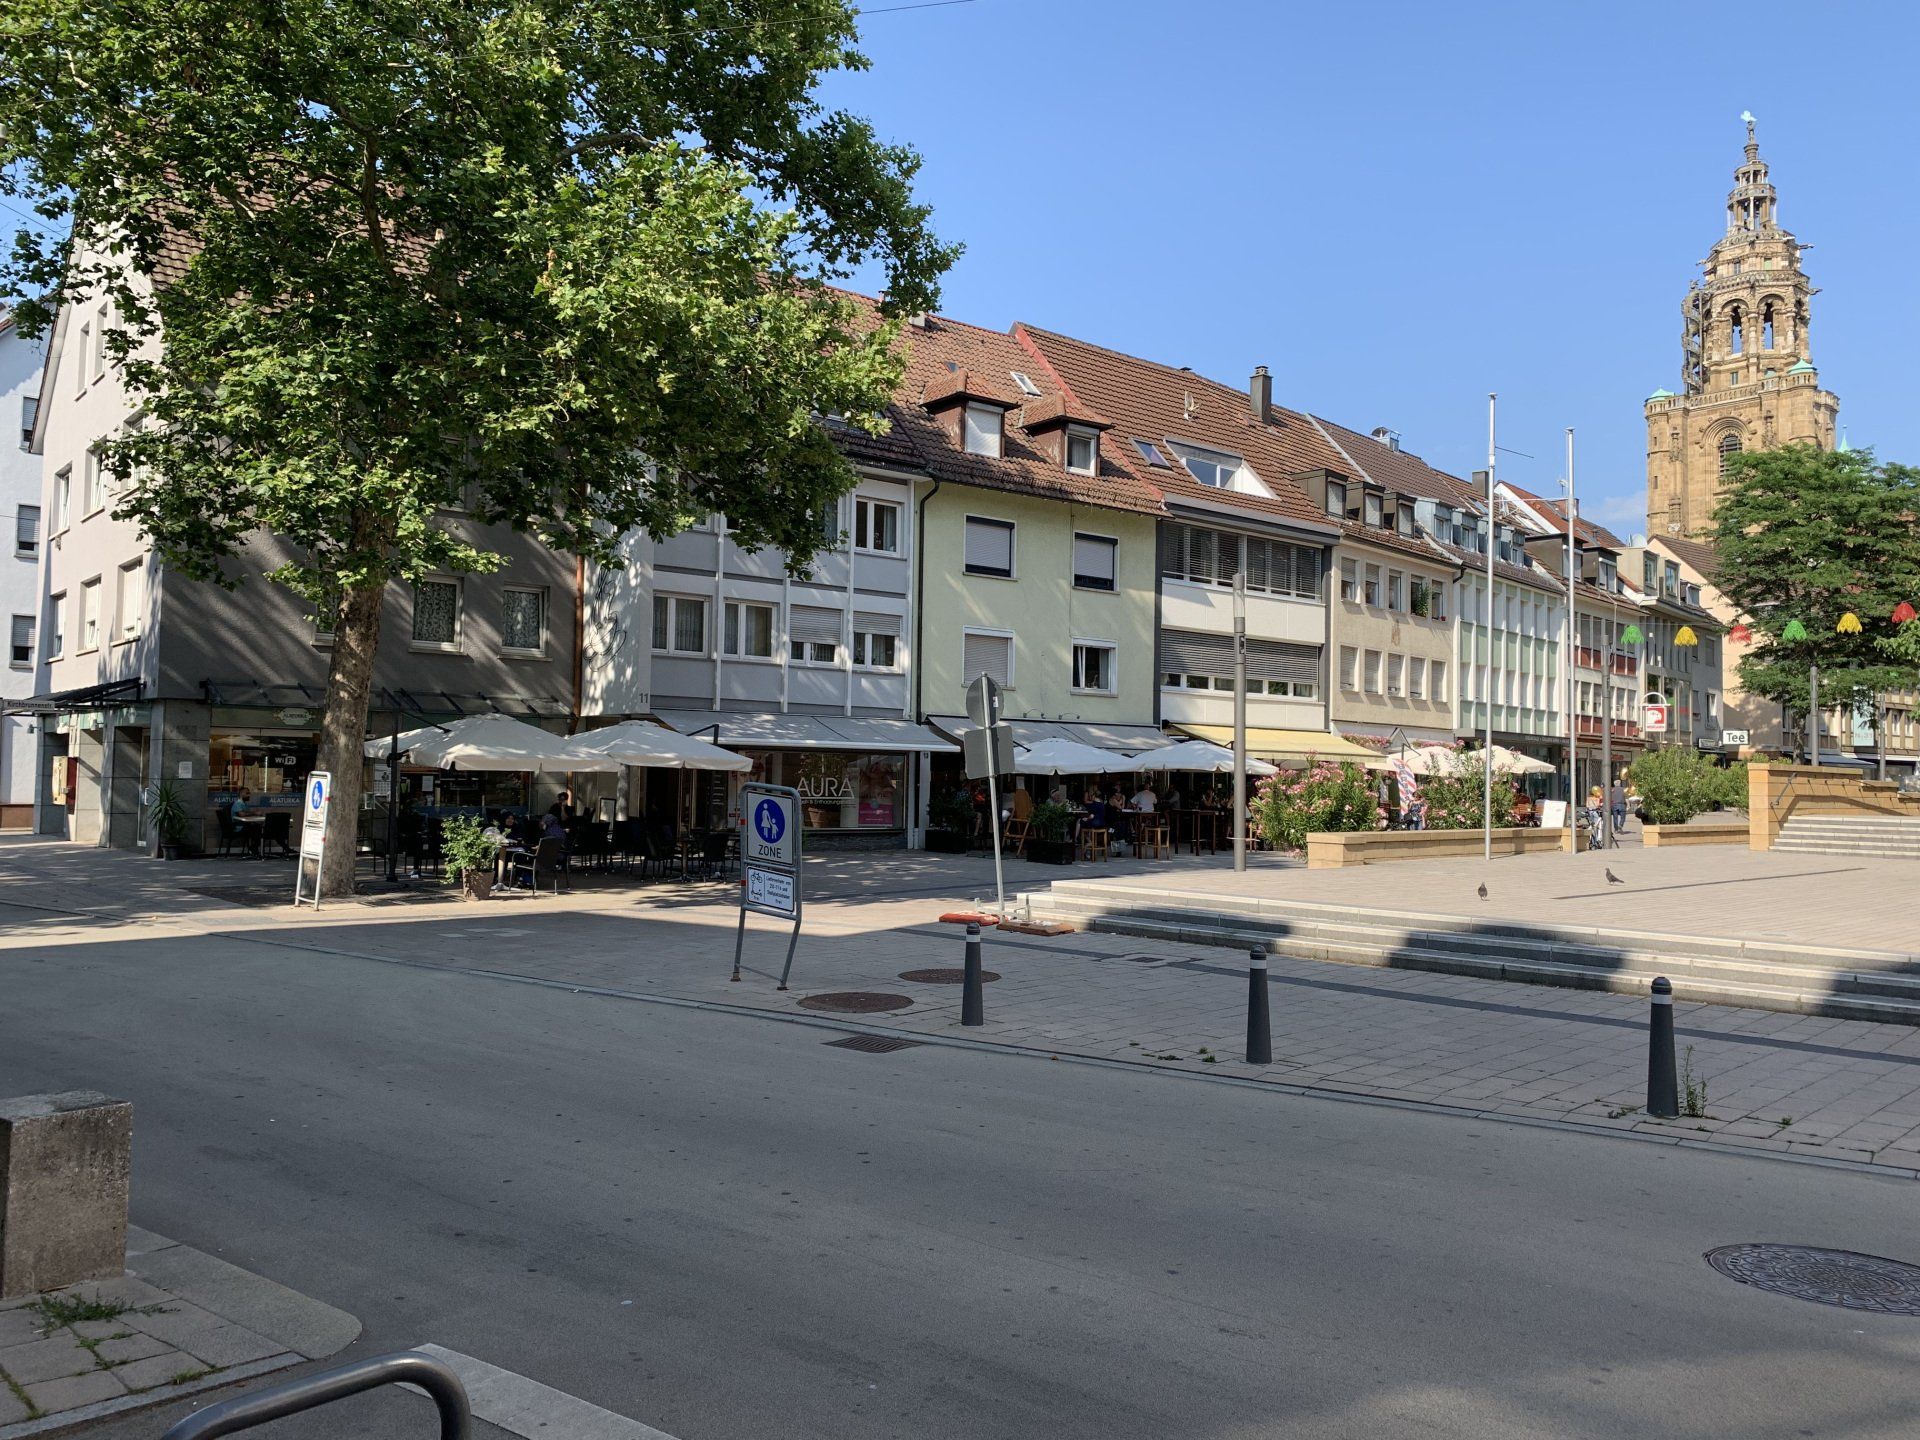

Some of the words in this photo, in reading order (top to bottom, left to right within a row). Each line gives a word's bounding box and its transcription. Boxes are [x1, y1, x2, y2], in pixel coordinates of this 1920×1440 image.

[639, 692, 648, 703] 11
[1726, 733, 1746, 743] Tee
[797, 777, 854, 798] AURA
[758, 844, 782, 859] ZONE
